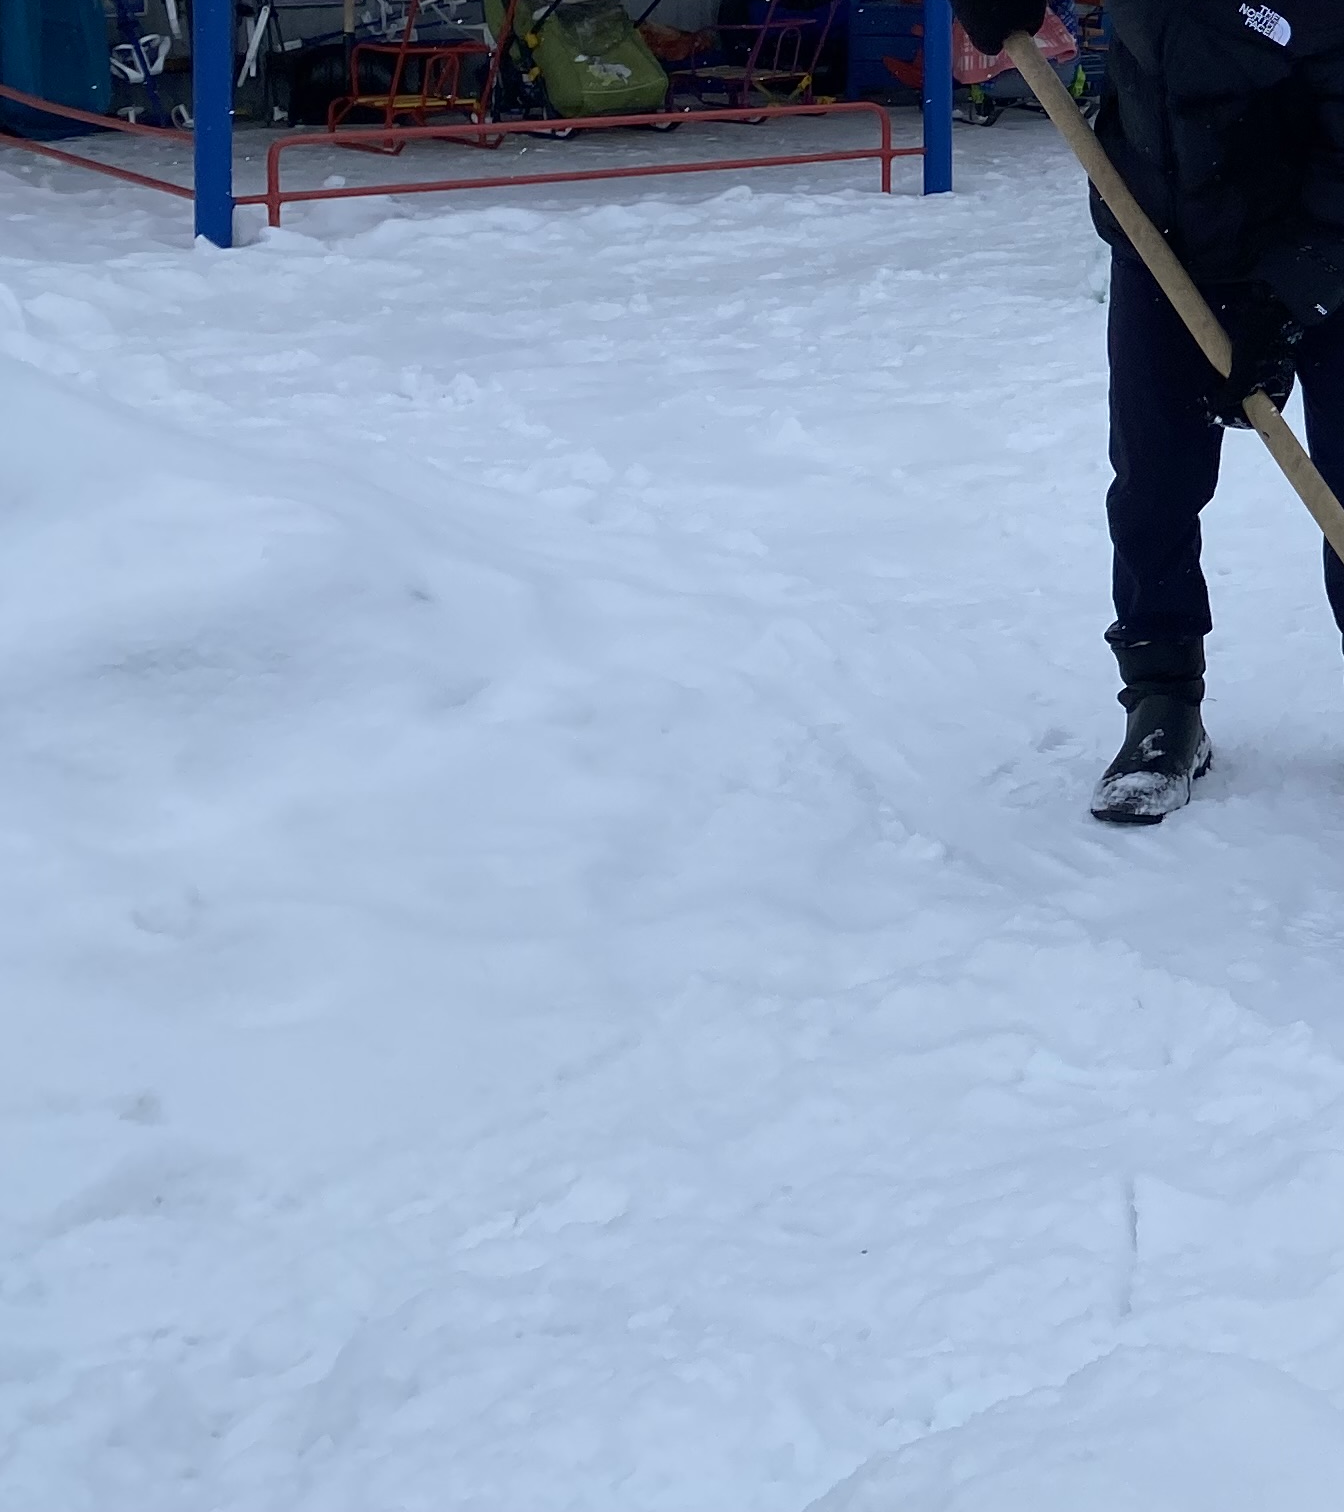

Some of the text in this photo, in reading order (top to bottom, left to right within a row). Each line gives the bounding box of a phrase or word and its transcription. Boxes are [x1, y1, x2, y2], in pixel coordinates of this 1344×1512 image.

[1238, 2, 1278, 29] NORTH
[1259, 4, 1281, 21] THE
[1244, 17, 1273, 36] FACE
